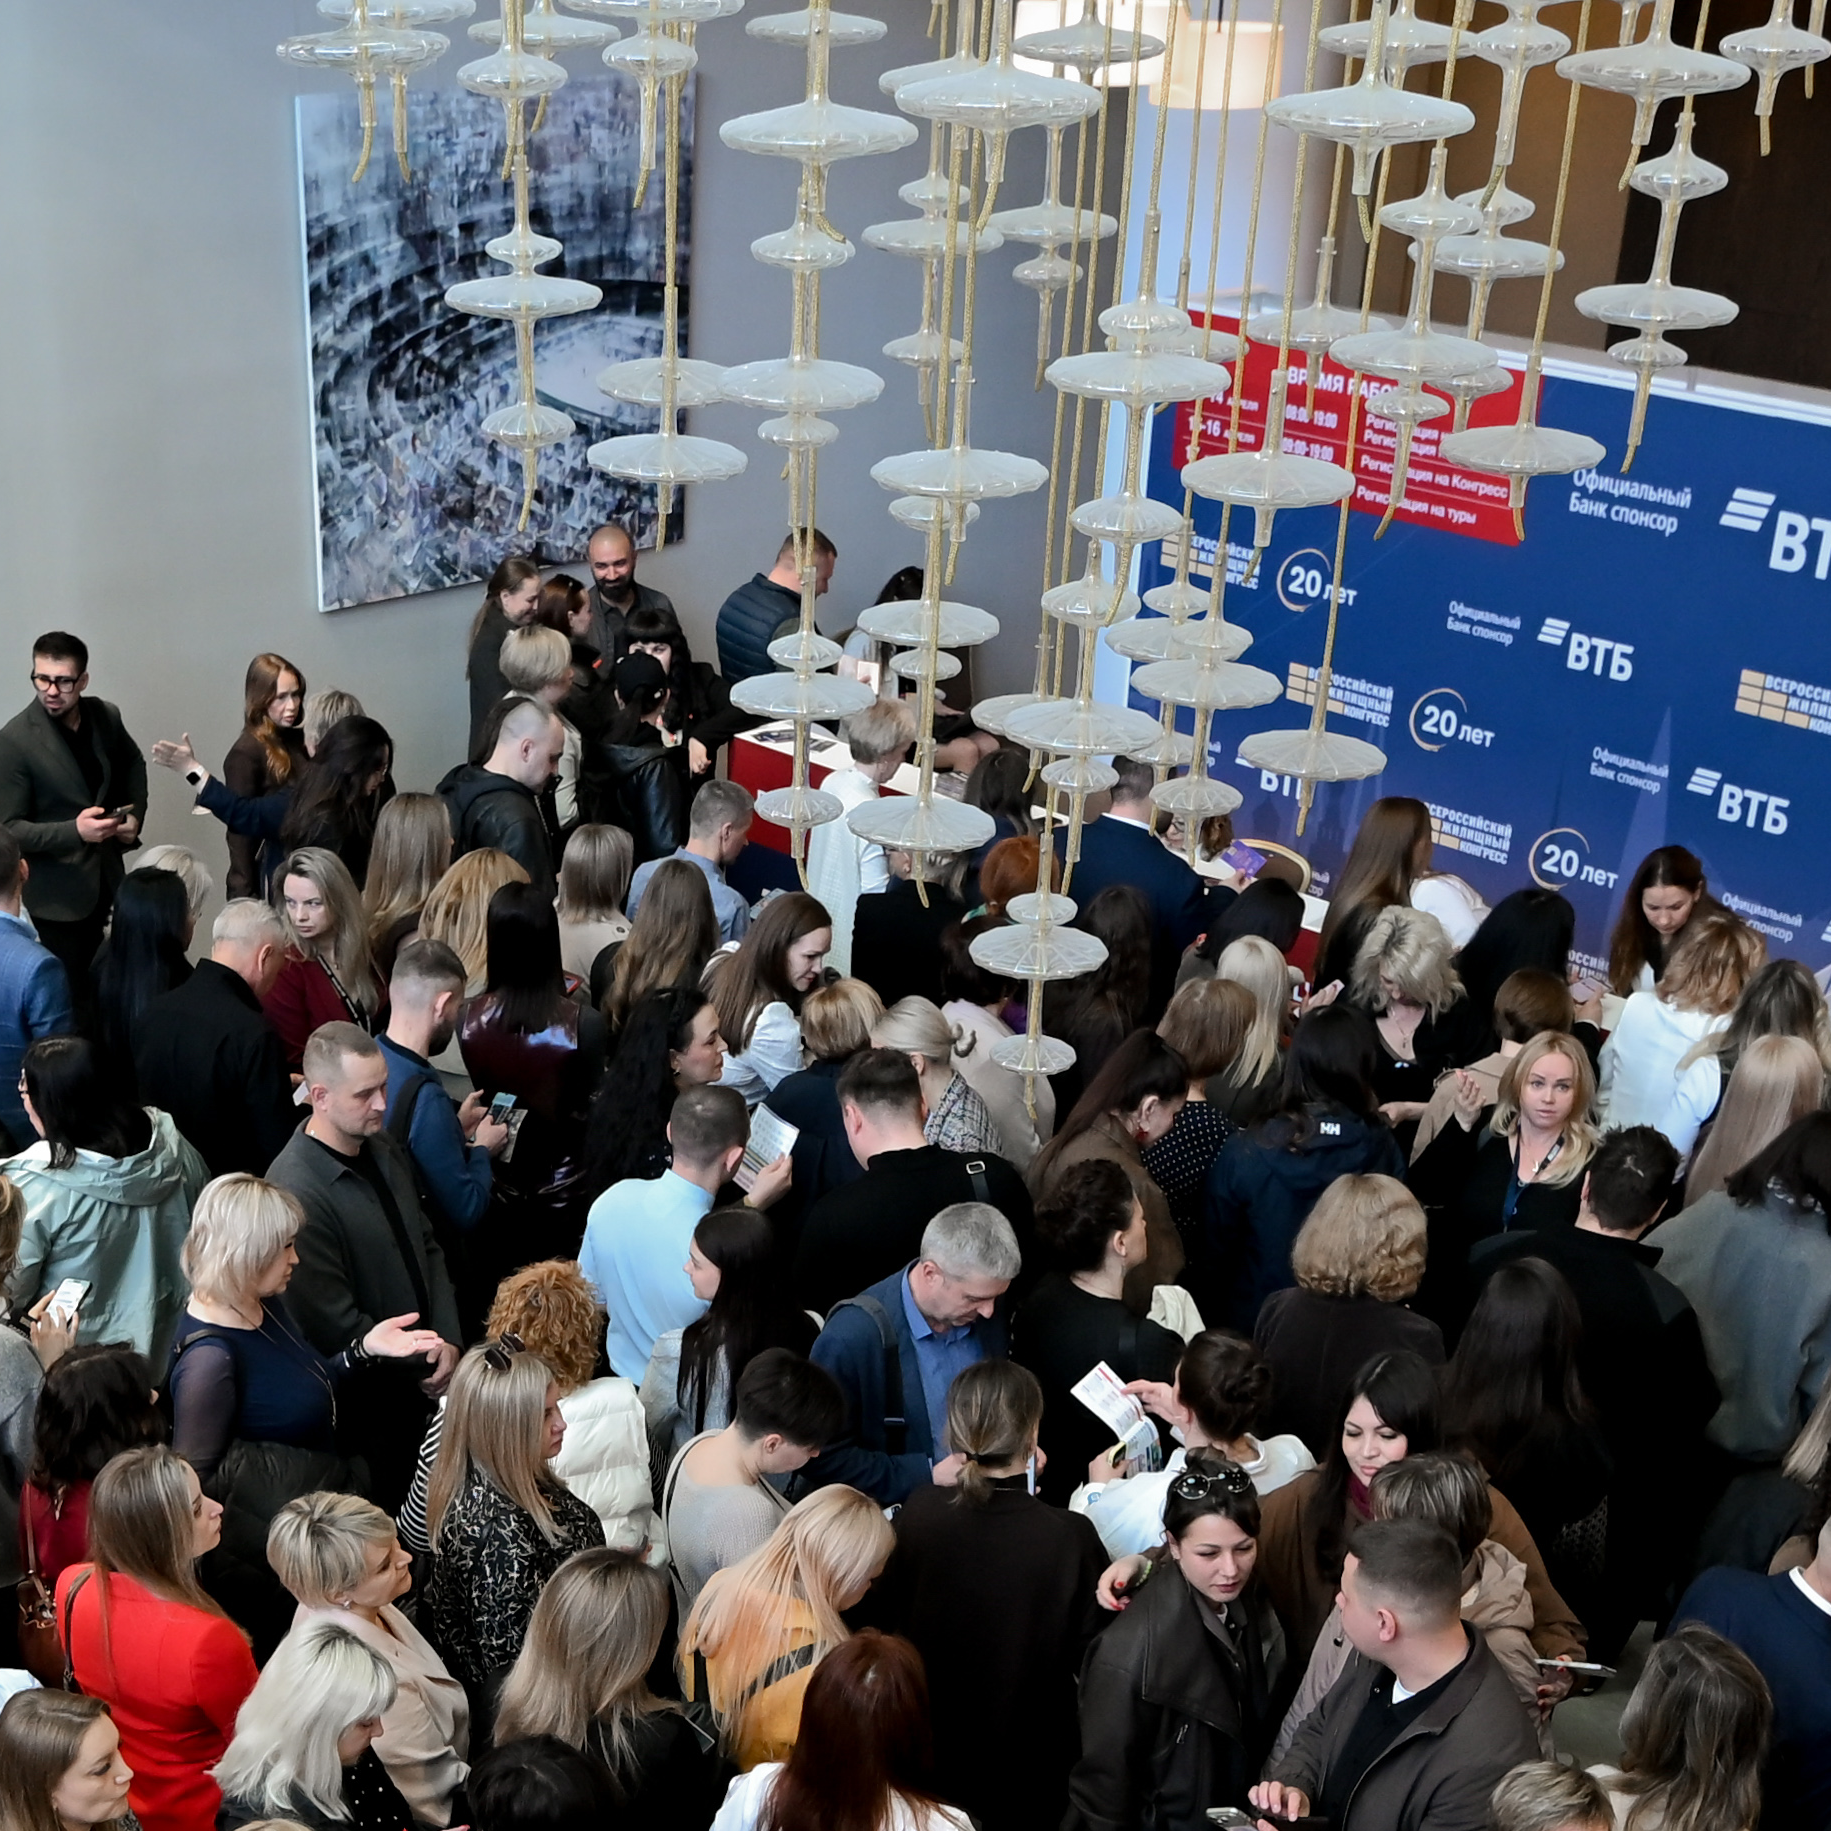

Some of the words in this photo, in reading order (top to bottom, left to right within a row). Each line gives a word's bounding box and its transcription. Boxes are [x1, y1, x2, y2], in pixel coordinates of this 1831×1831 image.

[1287, 366, 1345, 394] ВРМЯ
[1451, 474, 1508, 499] Конгресс
[1573, 468, 1692, 509] Официальный
[1447, 507, 1477, 525] туры
[1569, 492, 1607, 519] Банк
[1610, 504, 1679, 537] спонсор
[1288, 565, 1322, 598] 20
[1449, 600, 1521, 630] Официальный
[1447, 616, 1471, 635] Банк
[1472, 624, 1514, 647] спонсор
[1566, 632, 1635, 682] ВТБ
[1343, 704, 1390, 728] КОНГРЕСС
[1421, 704, 1457, 738] 20
[1457, 723, 1495, 748] лет
[1590, 761, 1616, 782] Банк
[1617, 771, 1661, 795] спонсор
[1592, 746, 1669, 778] Официальный
[1717, 783, 1790, 835] ВТБ
[1441, 820, 1510, 852] ЖИЛИЩНЫЙ
[1459, 841, 1508, 865] КОНГРЕСС
[1541, 843, 1580, 878] 20
[1579, 864, 1619, 890] лет
[1721, 892, 1803, 928] Официальный
